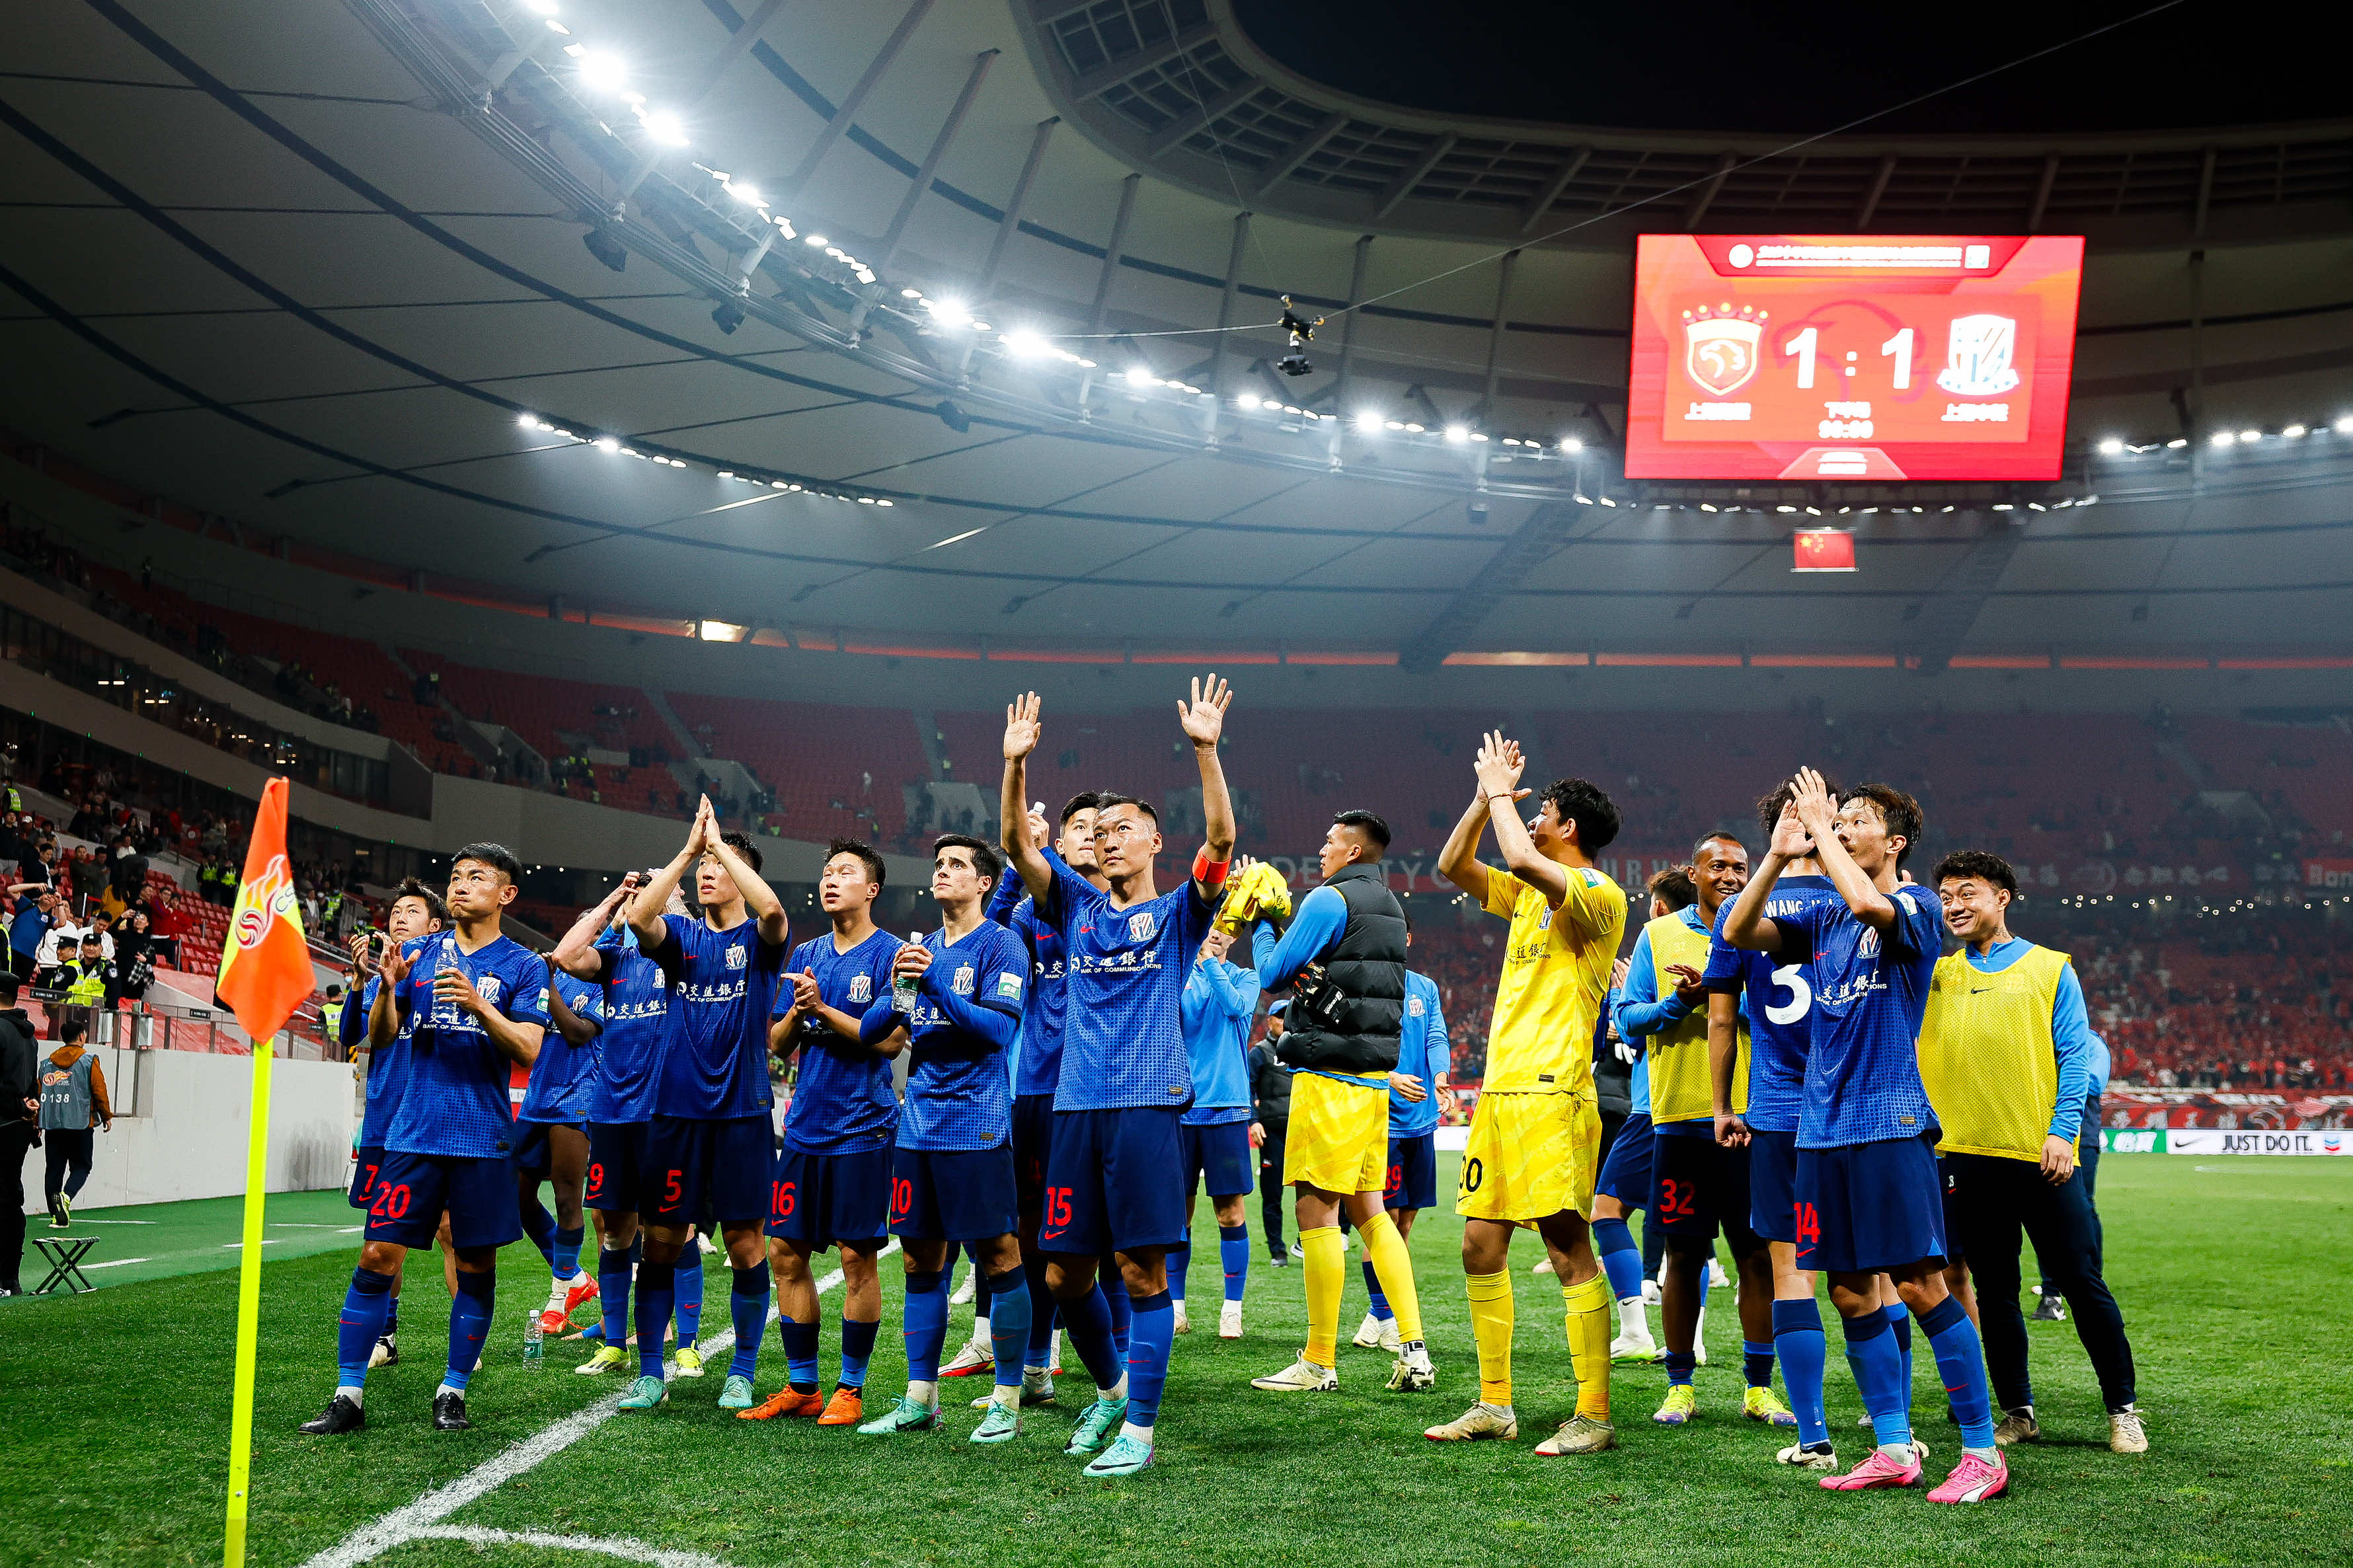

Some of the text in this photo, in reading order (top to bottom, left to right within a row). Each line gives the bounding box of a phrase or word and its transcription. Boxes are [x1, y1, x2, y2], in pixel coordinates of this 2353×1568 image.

[1785, 328, 1818, 389] 1
[1881, 328, 1914, 389] 1
[2222, 1135, 2259, 1151] JUST
[2266, 1135, 2289, 1151] DO
[365, 1164, 379, 1193] 7
[589, 1163, 603, 1192] 9
[664, 1170, 682, 1201] 5
[371, 1181, 411, 1219] 20
[772, 1180, 796, 1215] 16
[892, 1177, 912, 1214] 10
[1048, 1186, 1073, 1226] 15
[1660, 1179, 1695, 1214] 32
[1794, 1202, 1821, 1243] 14
